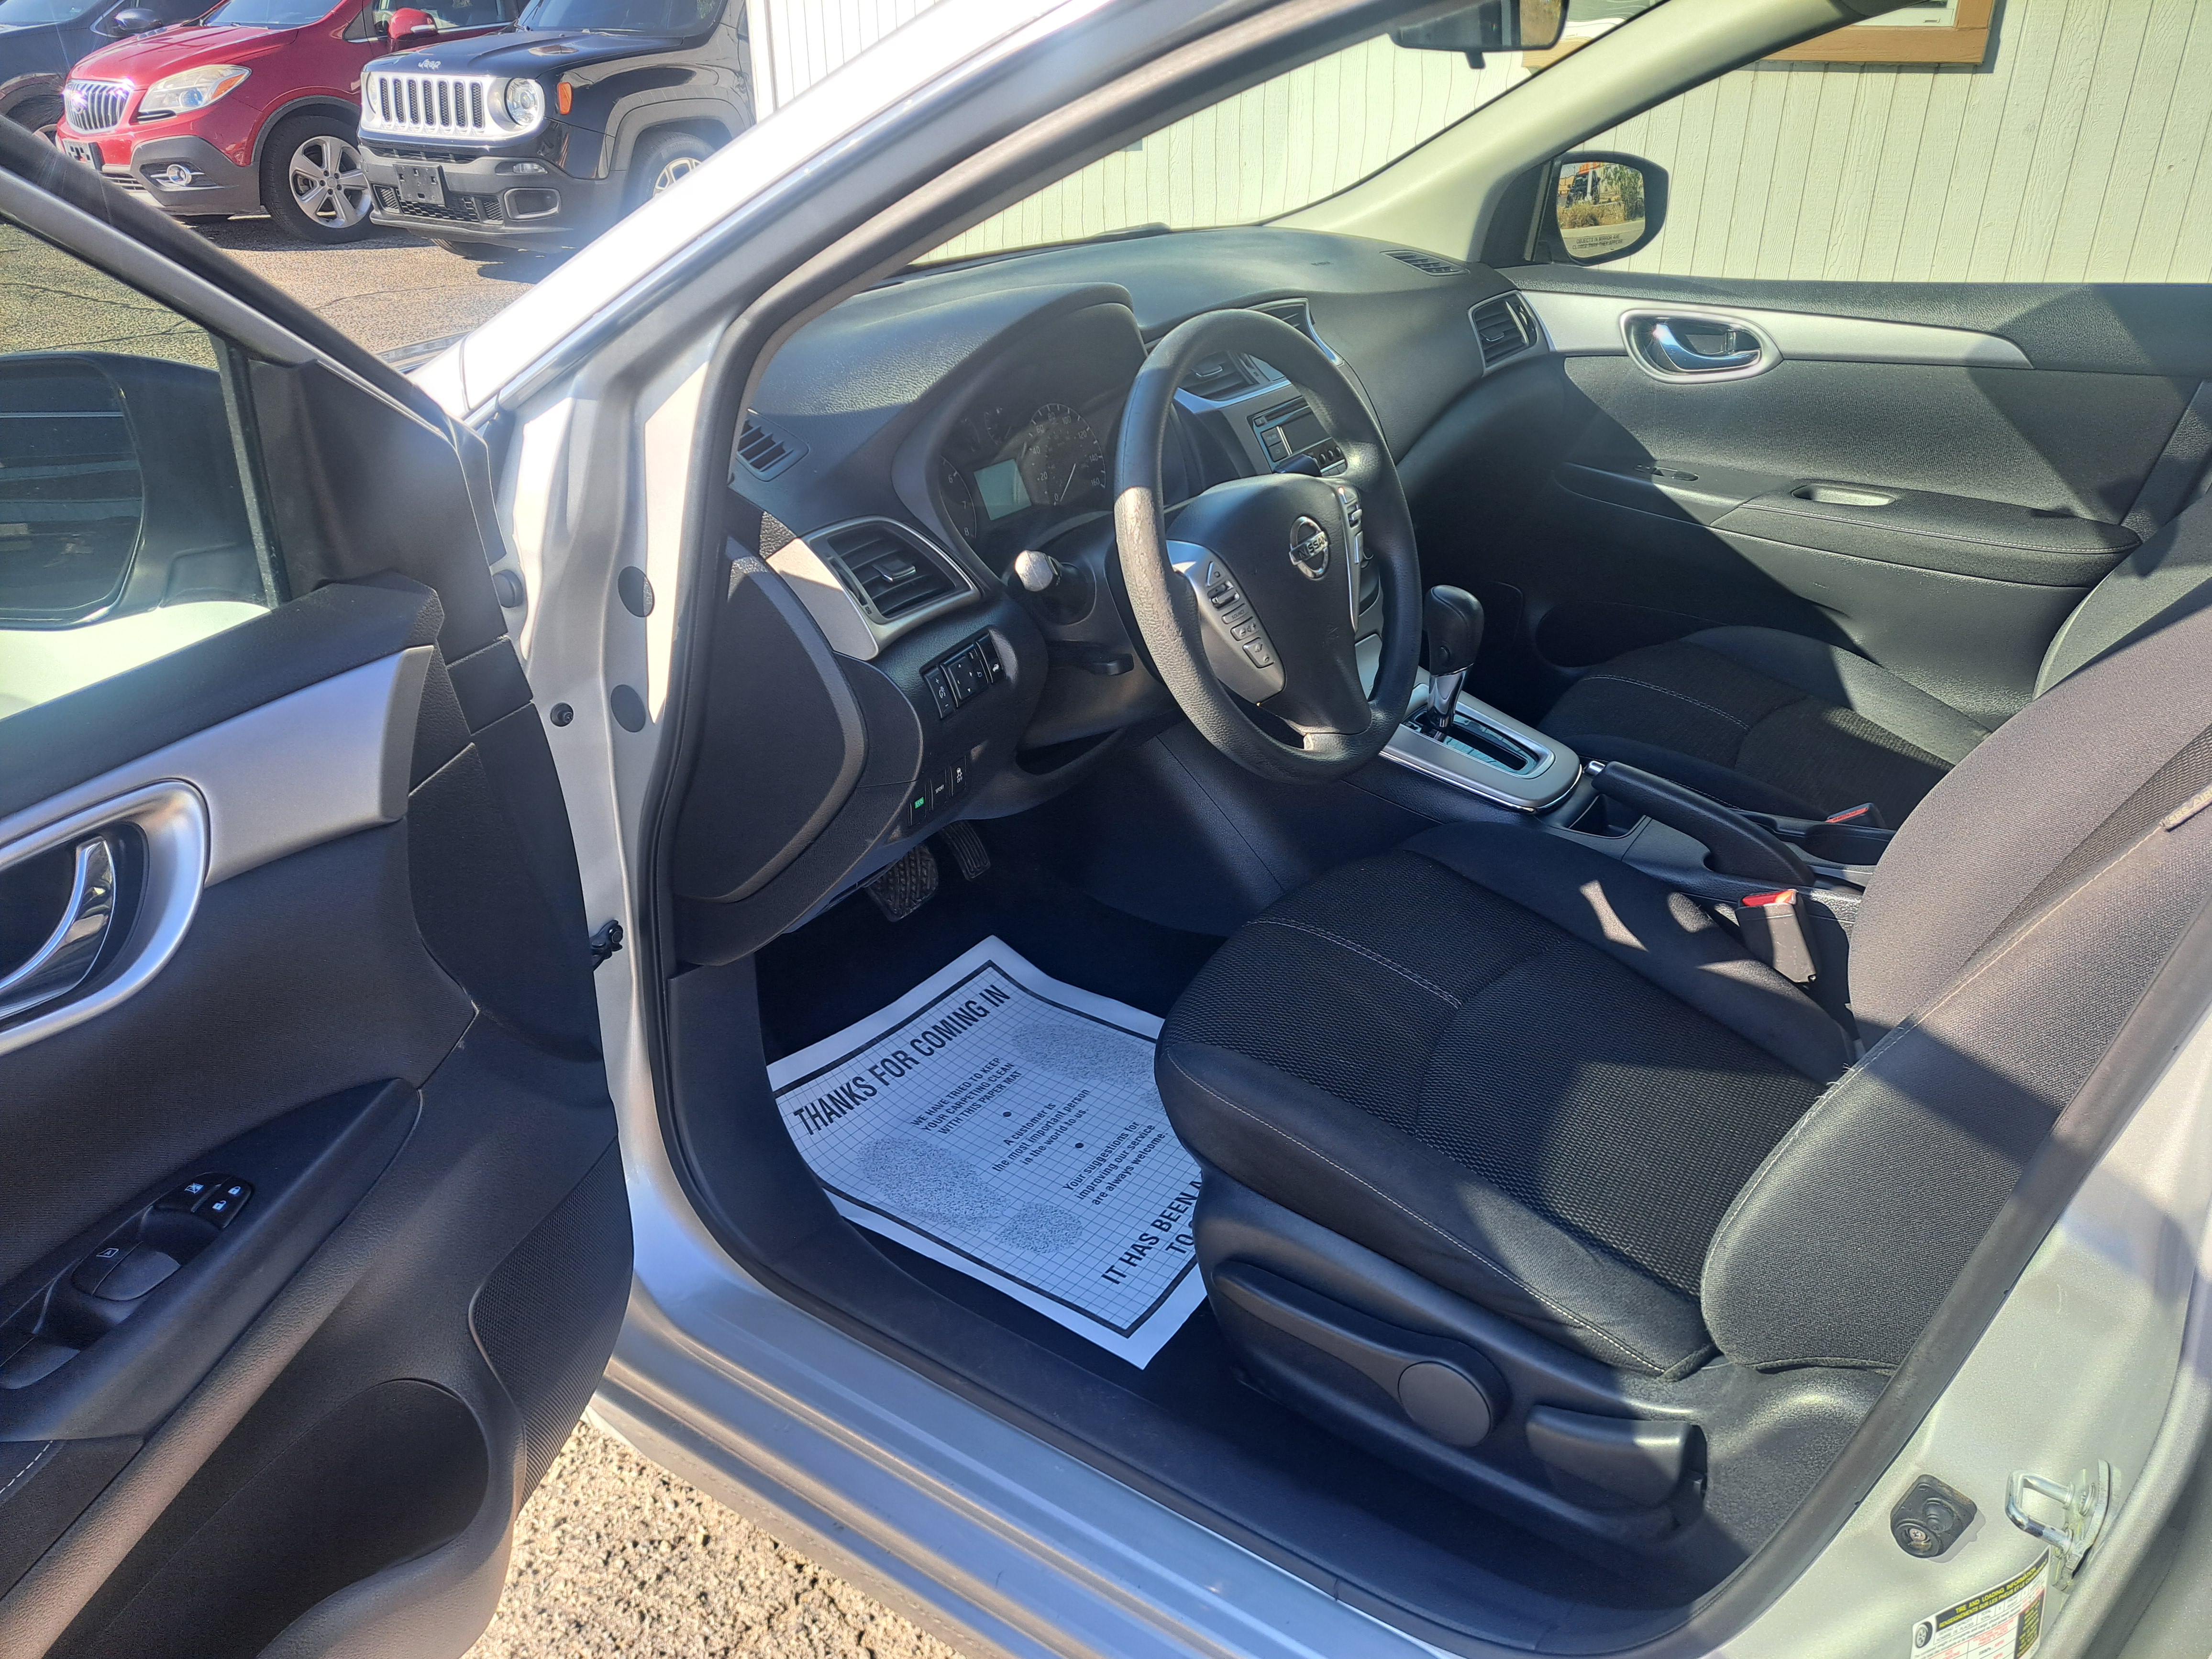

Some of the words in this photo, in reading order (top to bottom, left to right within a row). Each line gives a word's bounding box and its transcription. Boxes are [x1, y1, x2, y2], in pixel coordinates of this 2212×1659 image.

[418, 59, 441, 70] Jeep
[1078, 431, 1087, 439] 120
[1032, 446, 1040, 454] 40
[1089, 453, 1098, 462] 140
[948, 474, 953, 483] 6
[1040, 471, 1048, 481] 20
[1091, 477, 1100, 487] 160
[1054, 493, 1059, 501] 0
[964, 527, 970, 536] 8
[1298, 535, 1328, 558] NISSAN
[935, 784, 944, 794] SPORT
[2169, 806, 2190, 825] SRS
[794, 1076, 877, 1135] THANKS
[868, 1050, 920, 1086] FOR
[910, 1000, 990, 1056] COMING
[979, 984, 1011, 1007] IN
[911, 1115, 929, 1126] WE
[925, 1098, 950, 1116] HAVE
[946, 1081, 972, 1100] TRIED
[968, 1073, 984, 1082] TO
[980, 1057, 1001, 1073] KEEP
[921, 1114, 949, 1132] YOUR
[946, 1081, 991, 1115] CARPETING
[987, 1062, 1015, 1083] CLEAN
[938, 1117, 963, 1135] WITH
[959, 1102, 982, 1117] THIS
[978, 1084, 1006, 1104] PAPER
[1003, 1070, 1022, 1085] MAT
[992, 1160, 1010, 1172] the
[1007, 1142, 1030, 1160] most
[1026, 1111, 1067, 1143] important
[1063, 1089, 1090, 1113] person
[1012, 1109, 1048, 1140] customer
[1020, 1157, 1033, 1165] in
[1029, 1145, 1047, 1157] the
[1044, 1125, 1068, 1145] world
[1064, 1118, 1076, 1126] to
[1074, 1108, 1089, 1119] us.
[1062, 1173, 1086, 1191] Your
[1084, 1132, 1129, 1174] suggestions
[1124, 1121, 1140, 1132] for
[1074, 1163, 1118, 1200] improving
[1114, 1150, 1129, 1163] our
[1127, 1124, 1155, 1150] service
[1092, 1191, 1108, 1206] are
[1106, 1165, 1134, 1192] always
[1131, 1132, 1169, 1165] welcome.
[1101, 1265, 1127, 1285] IT
[1118, 1232, 1160, 1267] HAS
[1150, 1192, 1198, 1233] BEEN
[1165, 1234, 1194, 1254] TO
[1969, 1598, 1980, 1608] AND
[1981, 1588, 2005, 1602] LOADING
[2006, 1566, 2036, 1590] INFORMATION
[1989, 1597, 1998, 1605] LES
[2014, 1584, 2020, 1593] ET
